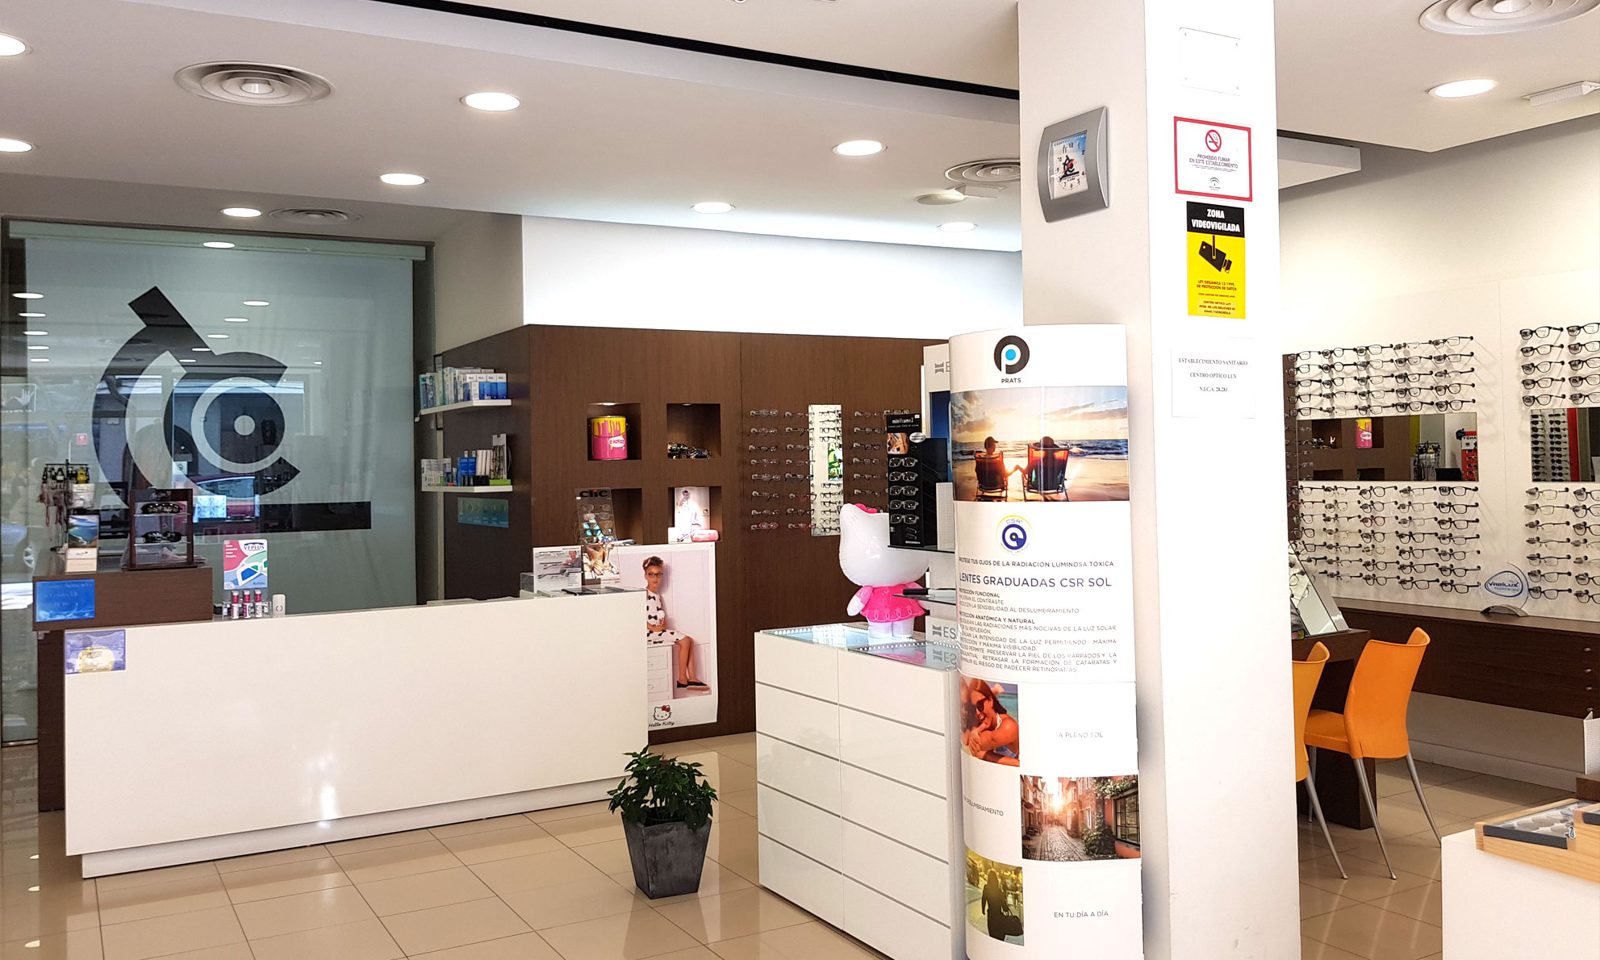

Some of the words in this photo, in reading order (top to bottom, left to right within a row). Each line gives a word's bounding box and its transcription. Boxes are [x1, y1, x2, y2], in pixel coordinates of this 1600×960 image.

[1206, 208, 1225, 219] ZONA
[1191, 218, 1240, 232] VIDEOVIGILADA
[1178, 357, 1222, 366] ESTABLECIMIENTO
[960, 572, 981, 584] LENTES
[982, 575, 1056, 588] GRADUADAS
[1060, 578, 1084, 588] CSR
[1088, 577, 1112, 587] SOL
[976, 590, 1000, 598] FUNCIONAL
[976, 602, 1008, 612] SENSIBILIDAD
[983, 620, 1018, 630] RADIACIONES
[979, 633, 1007, 643] INTENSIDAD
[986, 648, 1017, 658] PRESERVAR
[982, 654, 1009, 663] RETRASAR
[978, 660, 996, 668] RIESGO
[1066, 910, 1075, 918] TU
[1076, 910, 1088, 918] DÍA
[1097, 910, 1108, 918] DÍA
